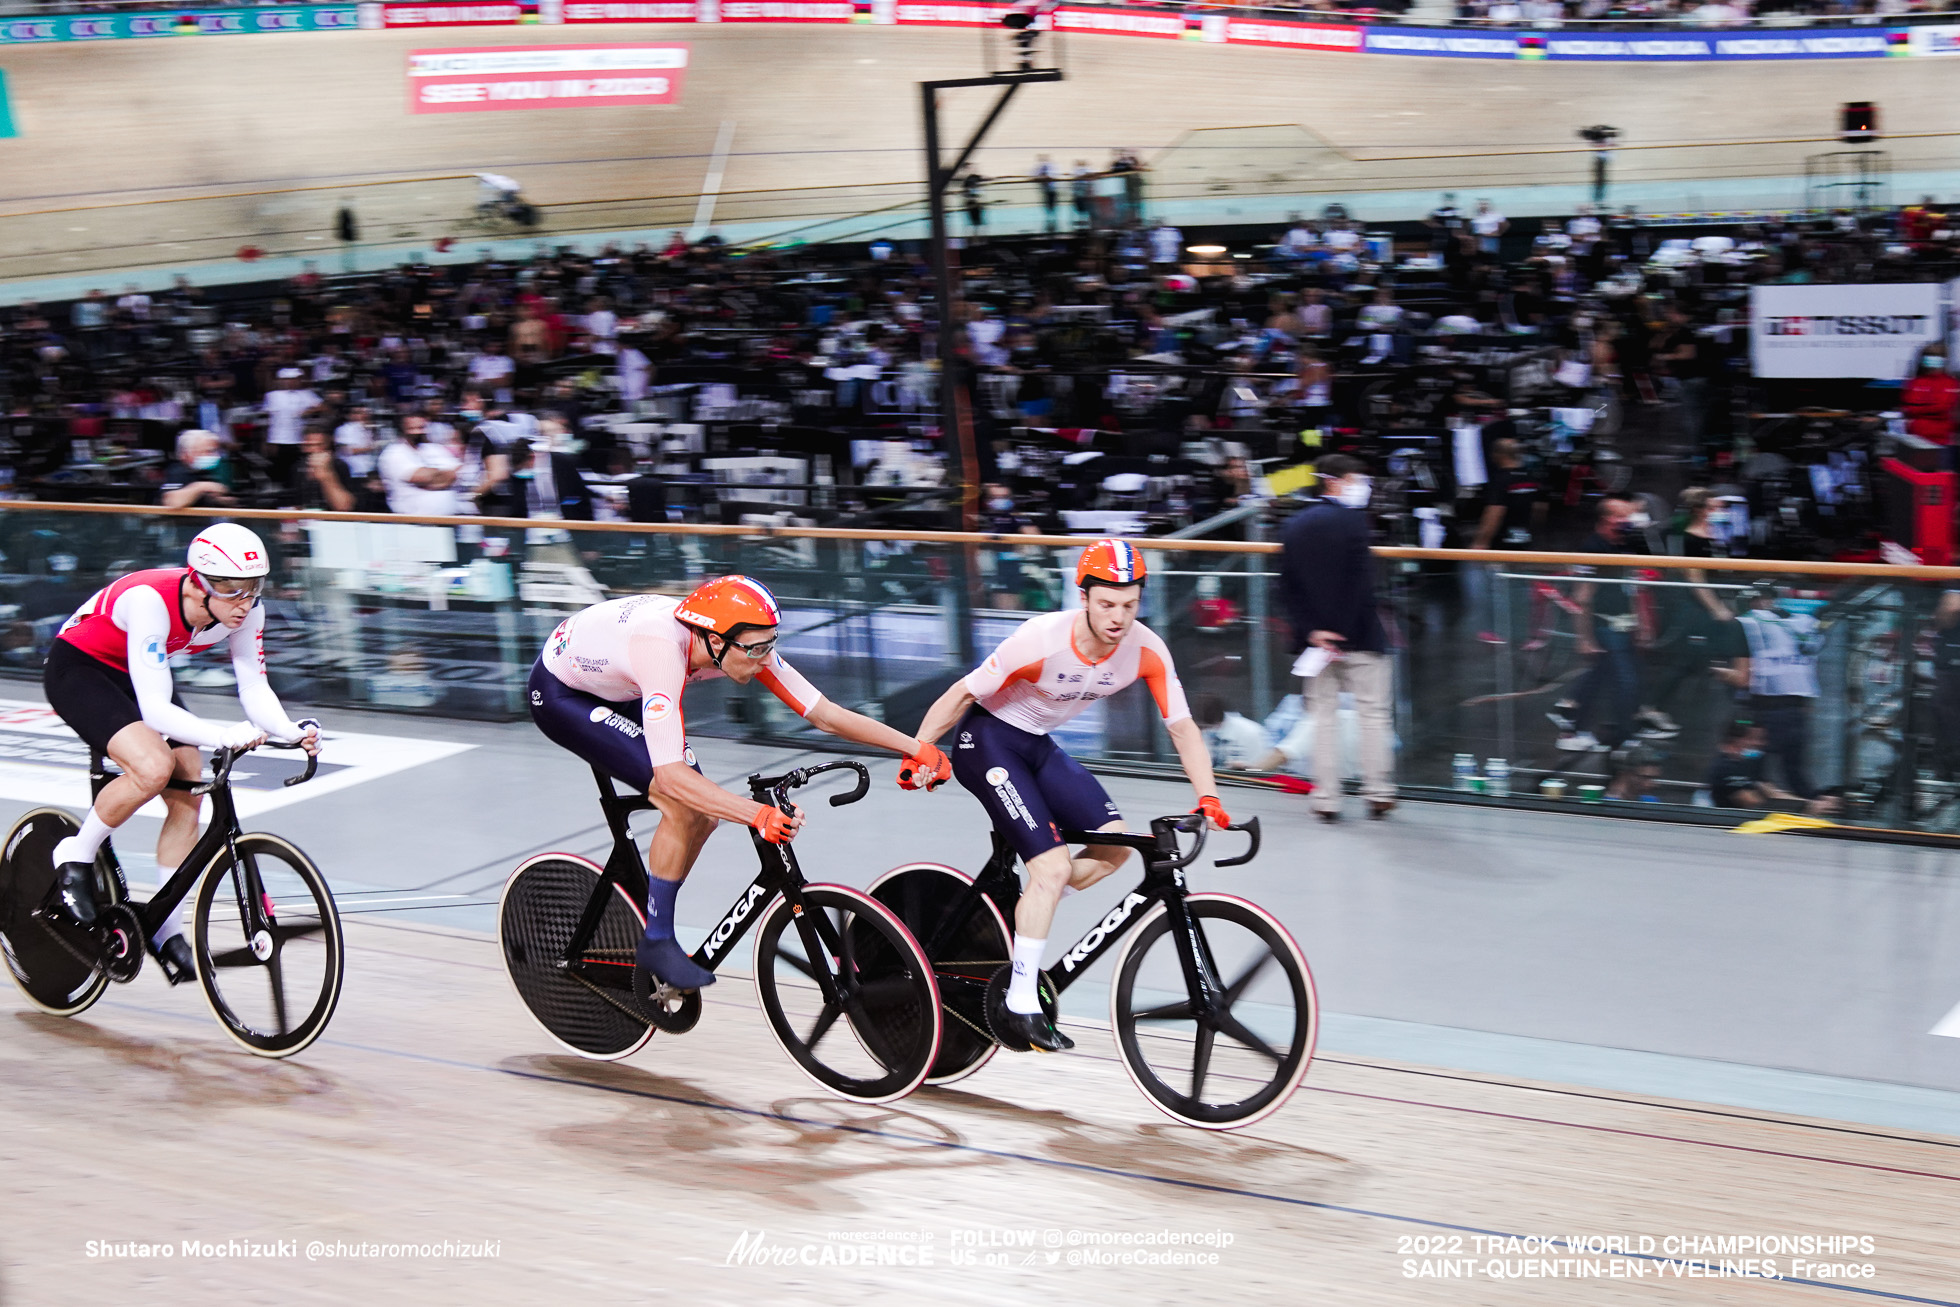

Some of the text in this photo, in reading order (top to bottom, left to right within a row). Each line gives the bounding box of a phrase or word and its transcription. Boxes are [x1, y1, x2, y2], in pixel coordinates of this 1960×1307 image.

[1808, 315, 1929, 335] TISSOT
[675, 606, 717, 630] LAZER
[703, 883, 767, 961] KOGA
[1062, 892, 1148, 973] KOGA
